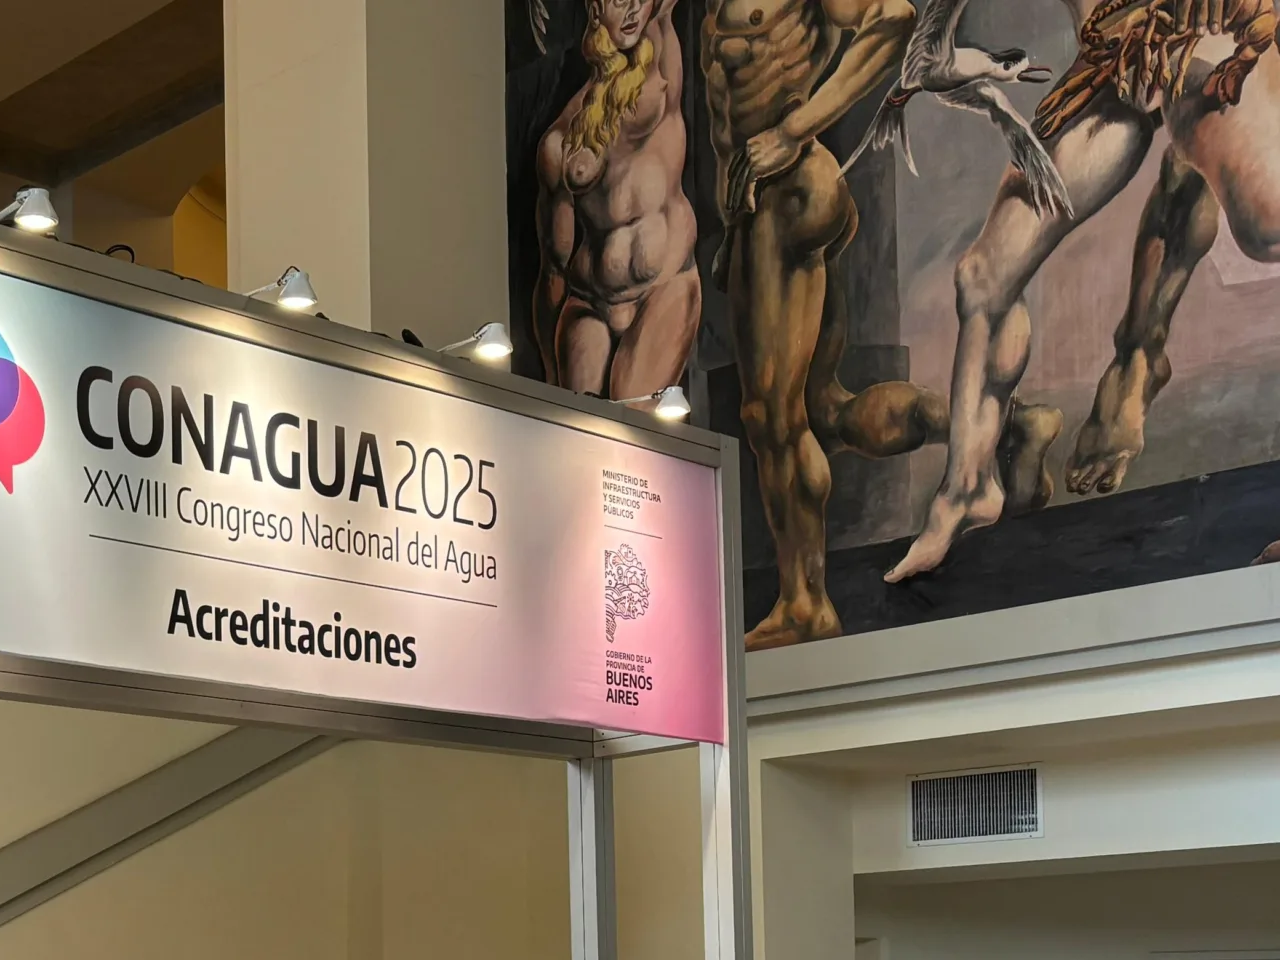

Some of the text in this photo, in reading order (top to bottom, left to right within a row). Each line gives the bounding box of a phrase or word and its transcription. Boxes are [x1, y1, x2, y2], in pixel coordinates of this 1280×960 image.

[602, 469, 649, 489] MINISTERIO DE
[602, 481, 662, 503] INFRAESTRUCTURA
[602, 493, 640, 510] Y SERVICIOS
[603, 504, 634, 520] PÚBLICOS
[83, 466, 498, 584] XXVIII Congreso Nacional del Agua
[167, 589, 417, 669] Acreditaciones
[605, 650, 652, 664] GOBIERNO DE LA
[606, 660, 645, 673] PROVINCIA DE
[606, 670, 653, 691] BUENOS
[606, 688, 639, 706] AIRES
